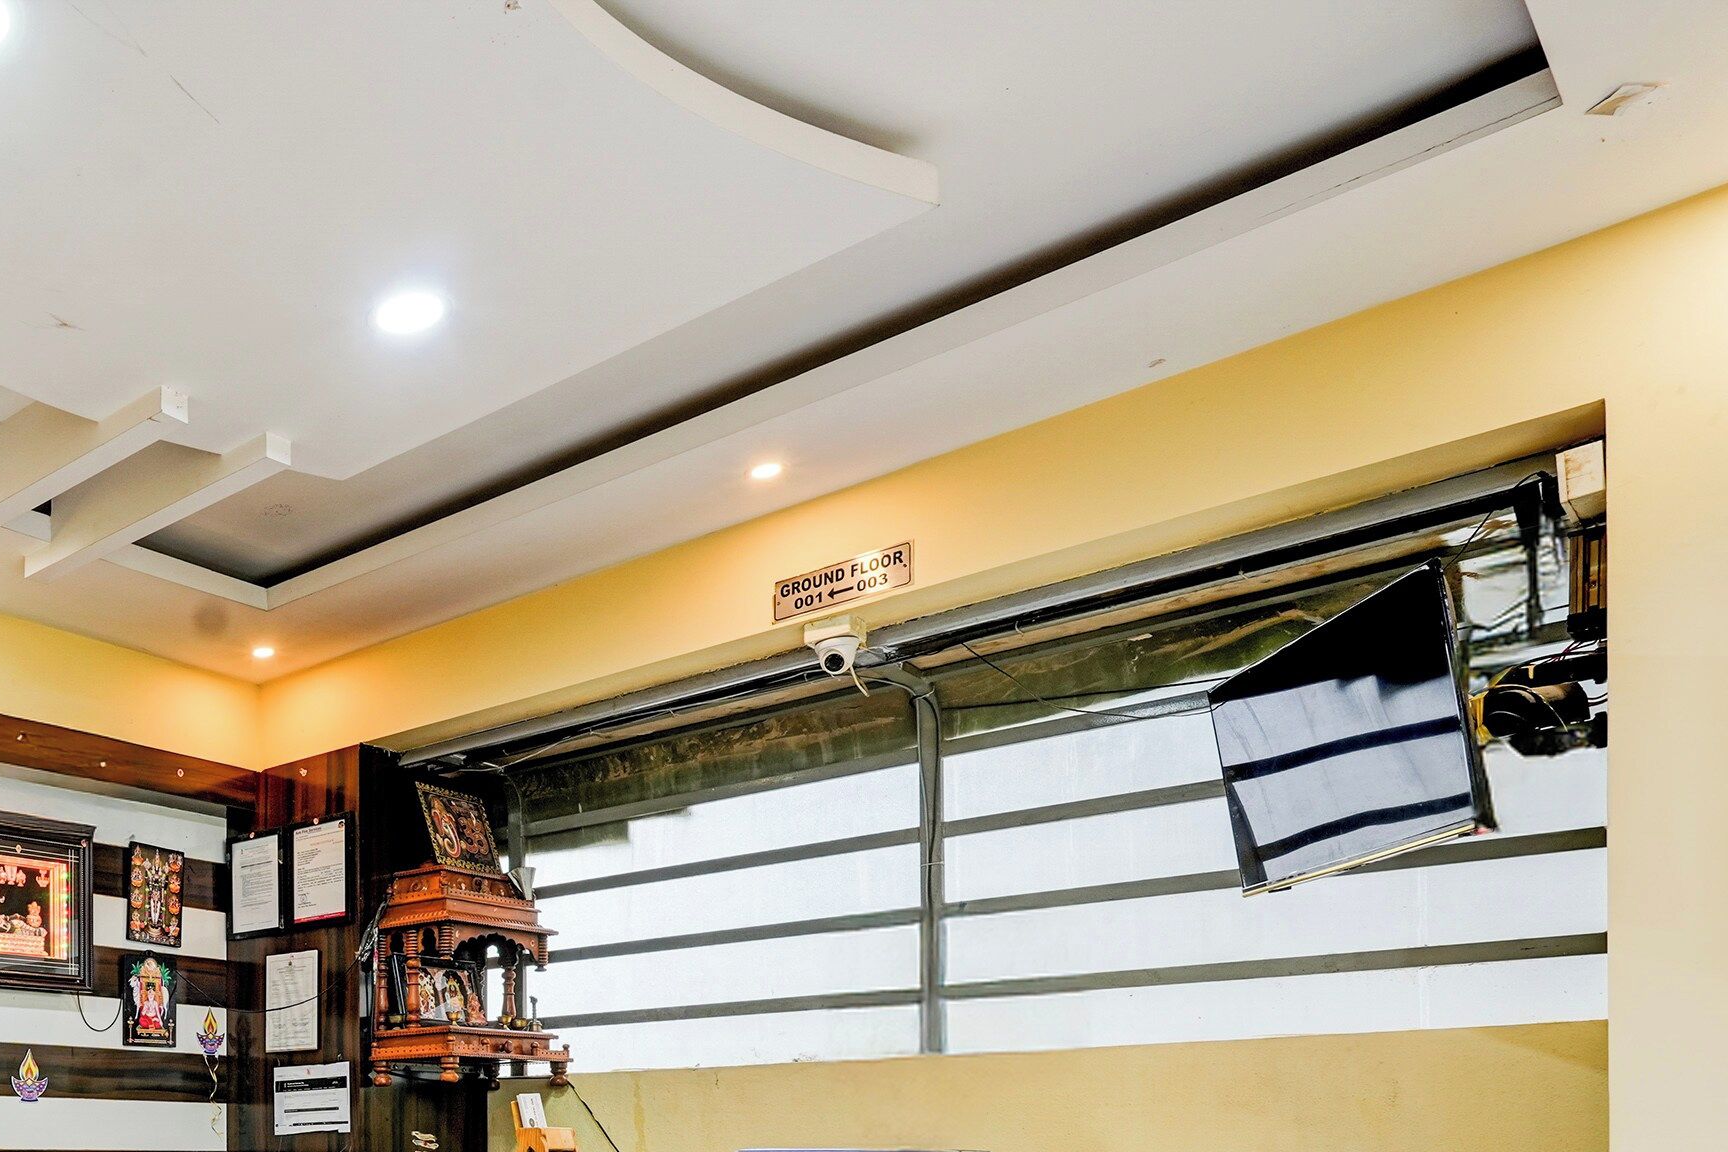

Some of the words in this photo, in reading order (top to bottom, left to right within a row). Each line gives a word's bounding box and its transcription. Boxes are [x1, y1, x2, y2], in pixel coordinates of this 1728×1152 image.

[780, 567, 845, 598] GROUND
[850, 550, 904, 578] FLOOR
[794, 591, 823, 610] 001
[857, 573, 889, 592] 003
